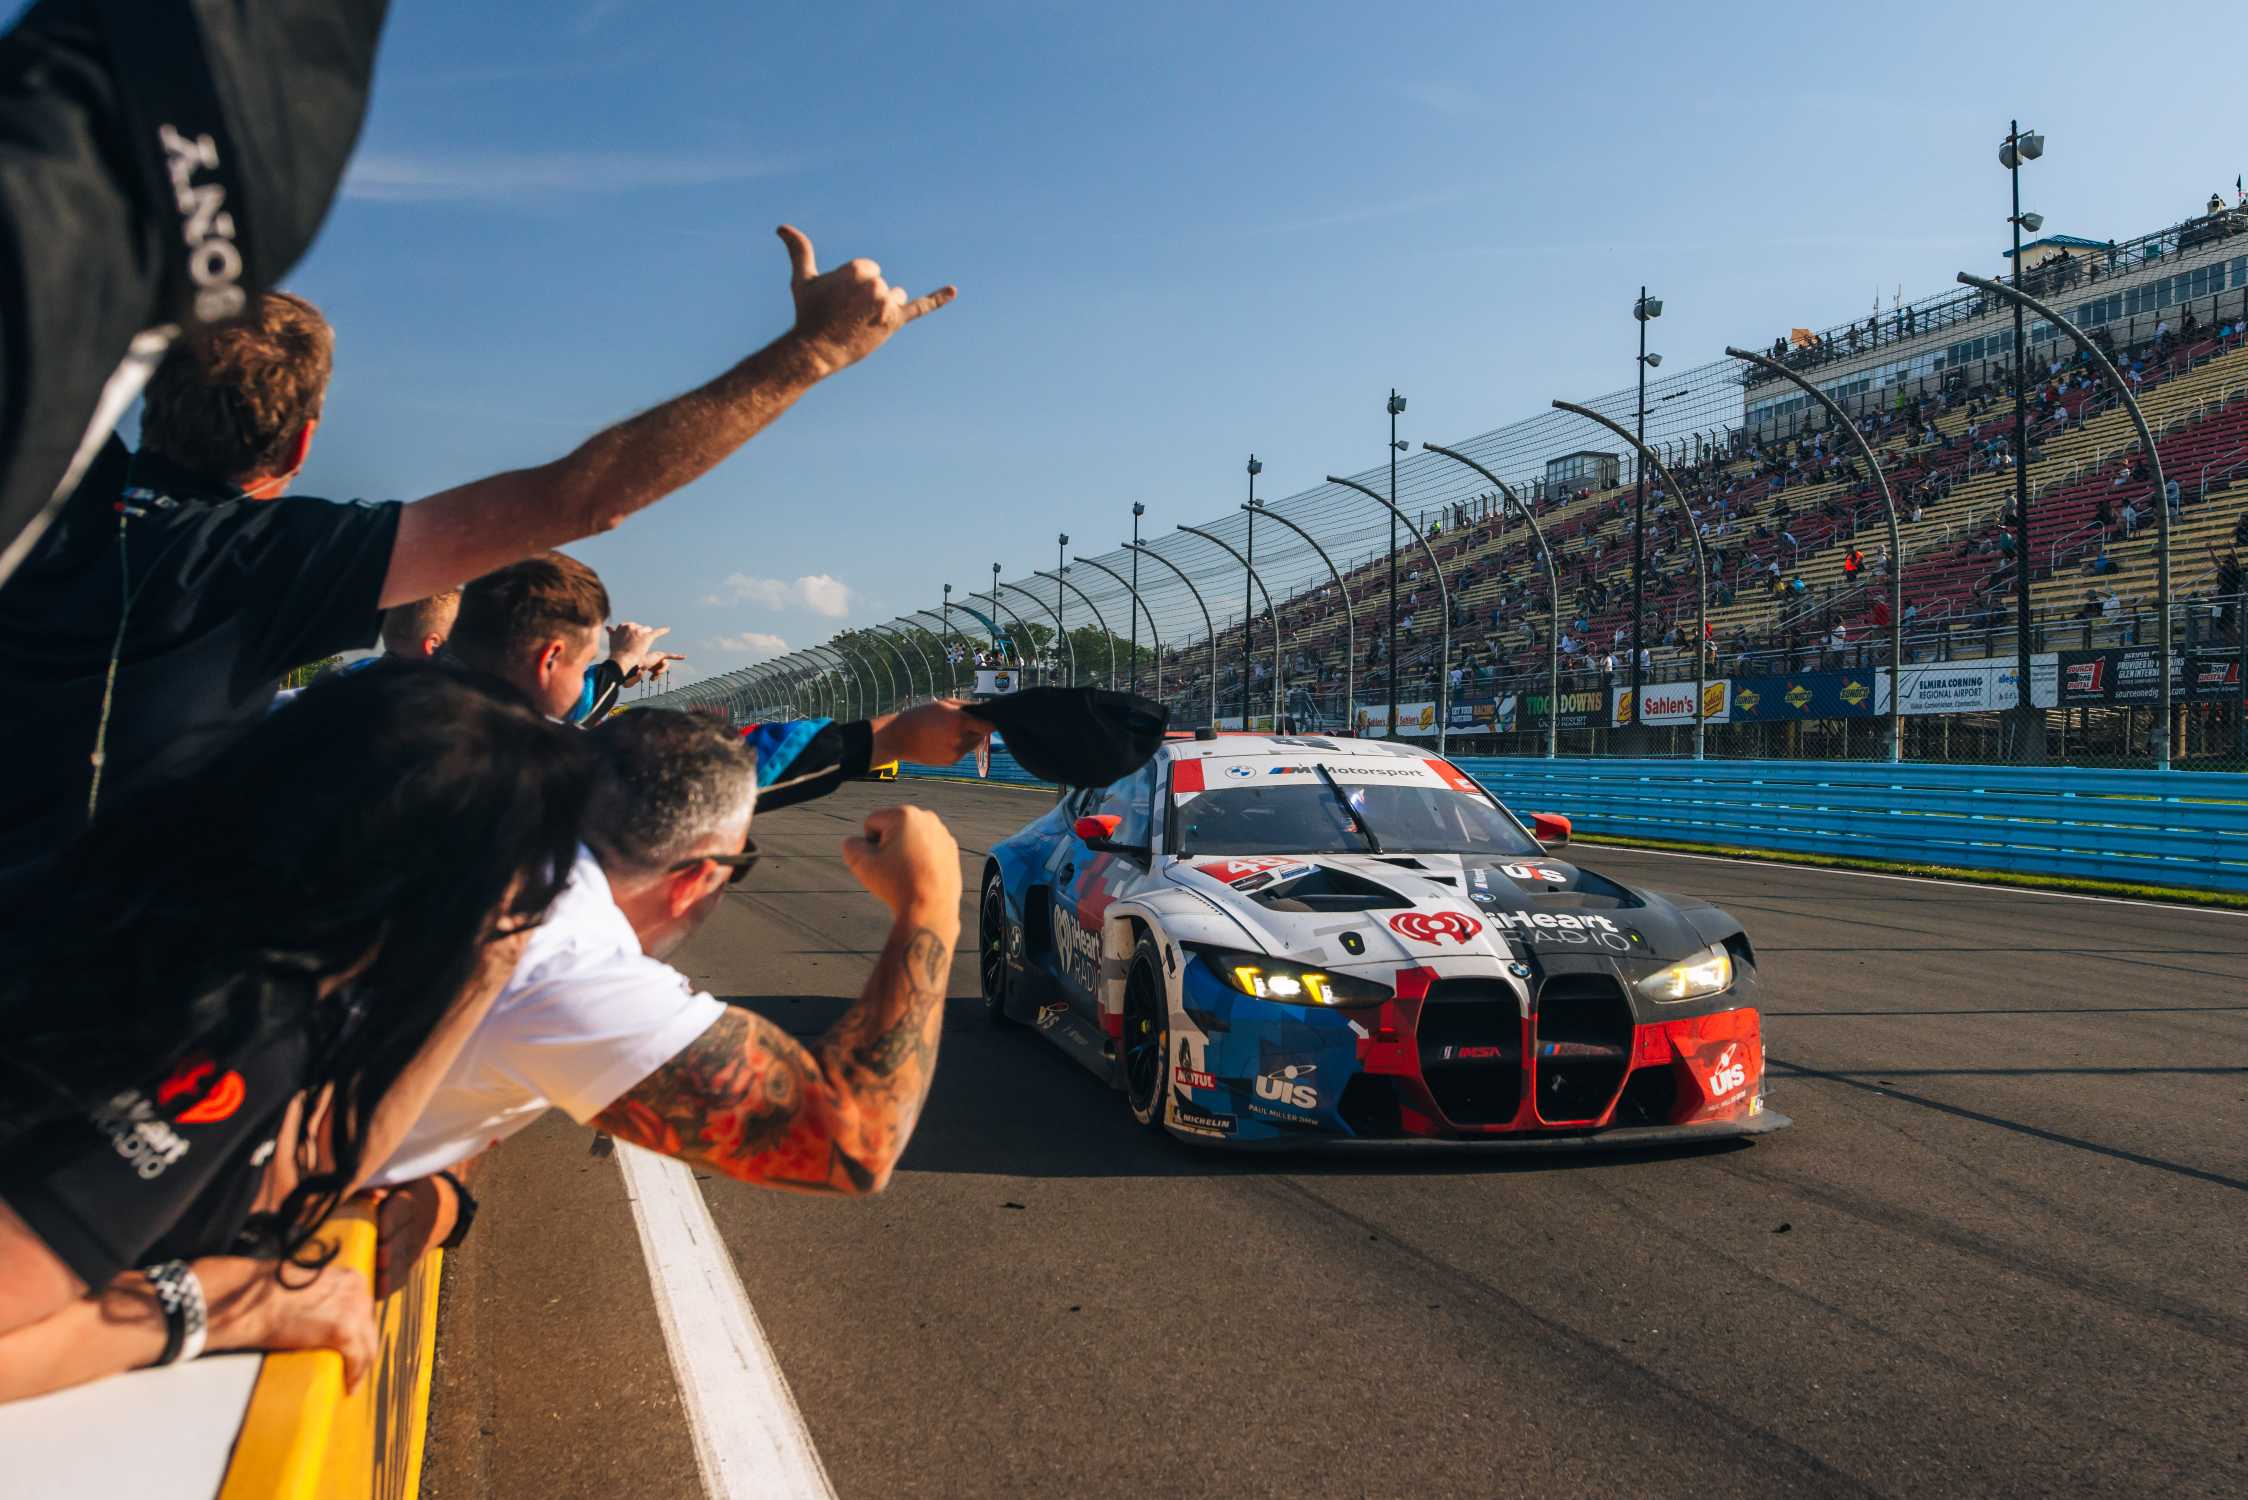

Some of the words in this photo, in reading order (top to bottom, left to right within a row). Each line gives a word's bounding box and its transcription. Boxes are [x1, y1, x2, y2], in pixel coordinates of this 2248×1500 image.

[159, 122, 246, 323] SONY
[2067, 664, 2094, 673] SOURCE
[1919, 680, 1946, 690] ELMIRA
[1948, 677, 1983, 687] CORNING
[1919, 689, 1952, 700] REGIONAL
[1953, 686, 1983, 698] AIRPORT
[1560, 692, 1602, 713] DOWNS
[1644, 694, 1694, 716] Sahlen's
[1486, 910, 1620, 934] iHeart
[1501, 929, 1631, 951] RADIO
[1072, 952, 1099, 992] RADI
[1177, 1069, 1215, 1088] MOTUL
[1182, 1112, 1231, 1129] MICHELIN
[1249, 1103, 1266, 1116] PAUL
[1268, 1108, 1298, 1122] MILLER
